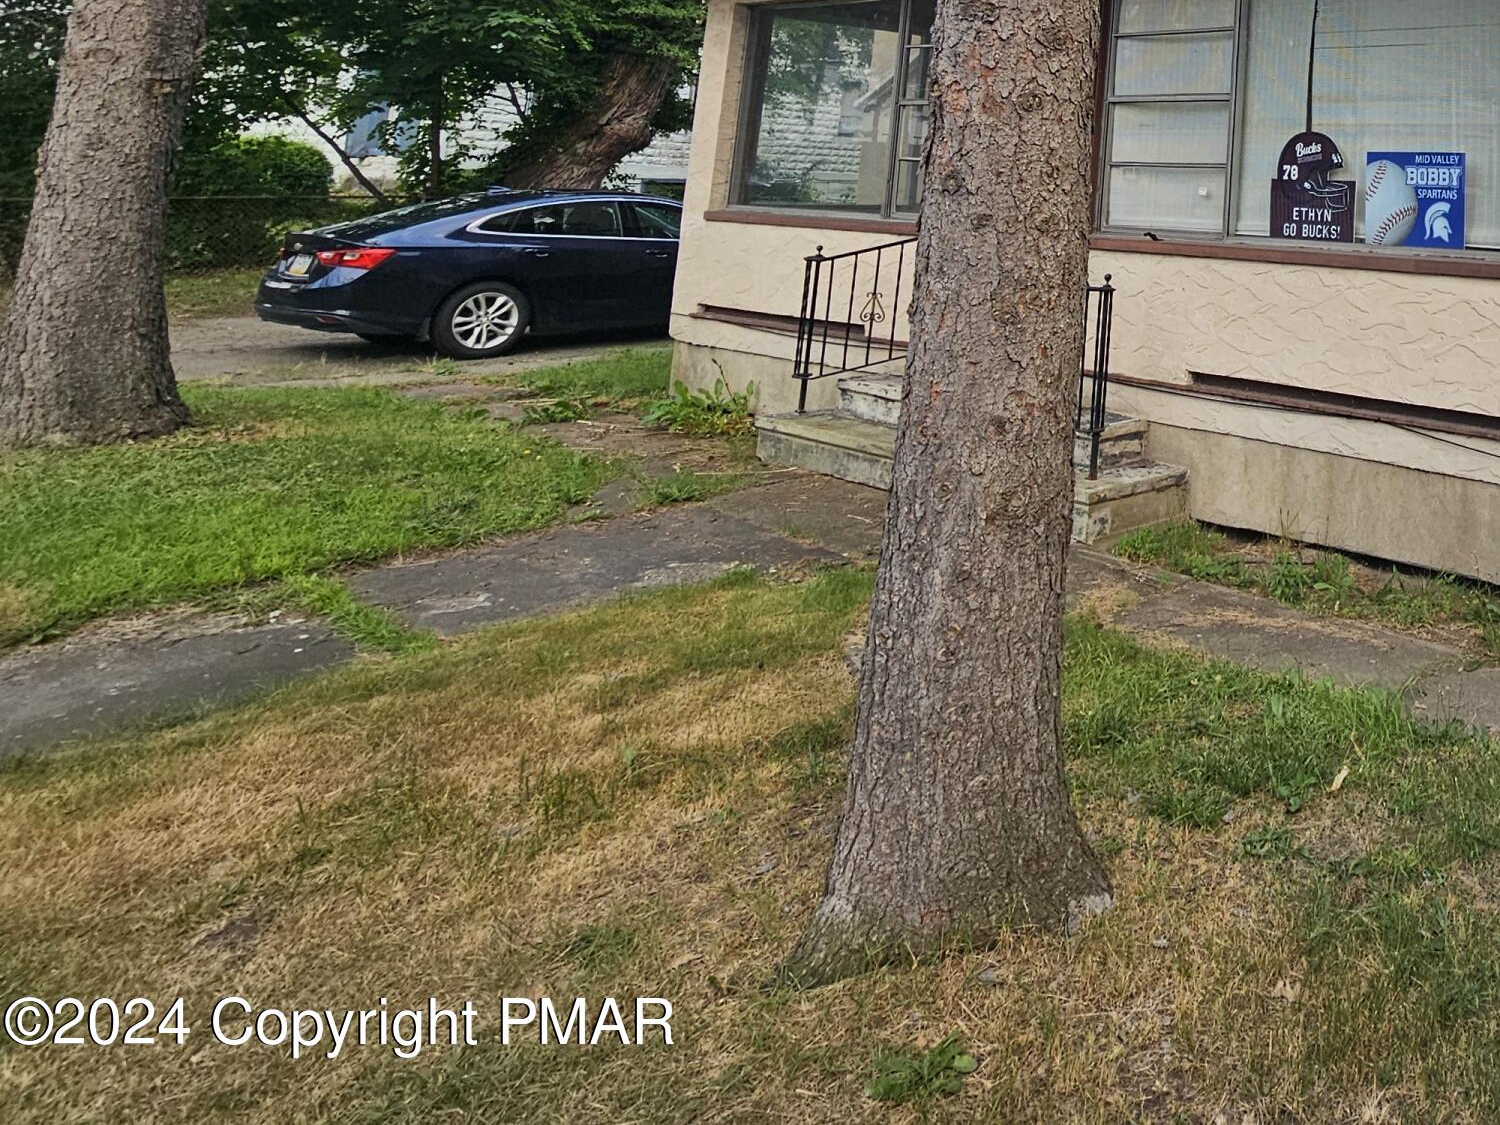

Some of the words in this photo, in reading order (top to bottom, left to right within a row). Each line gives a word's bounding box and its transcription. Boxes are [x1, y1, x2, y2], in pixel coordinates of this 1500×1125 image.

[1295, 142, 1321, 157] Bucks
[1415, 156, 1430, 164] MID
[1432, 156, 1460, 164] VALLEY
[1405, 167, 1461, 187] BOBBY
[1417, 189, 1458, 200] SPARTANS
[1293, 208, 1332, 221] ETHYN
[1283, 223, 1297, 236] GO
[1302, 224, 1341, 239] BUCKS!
